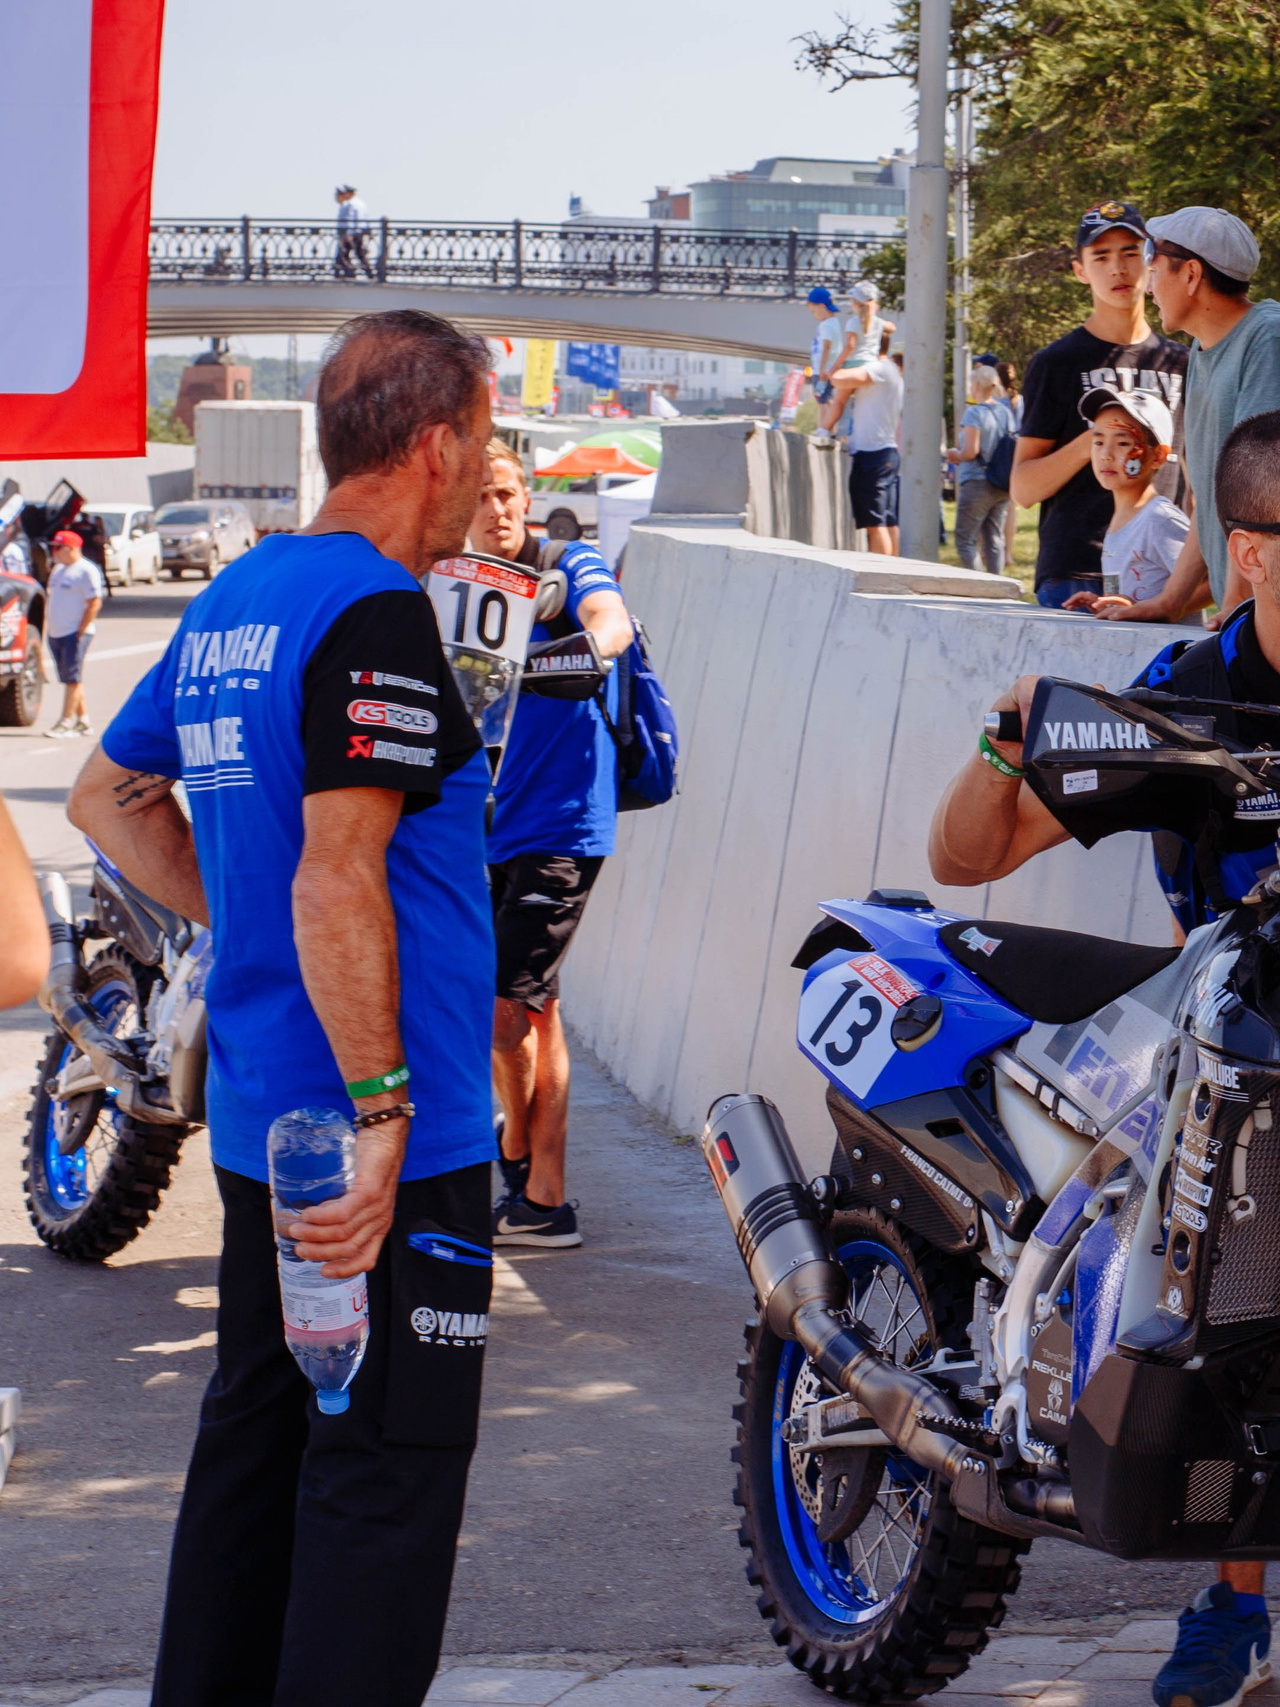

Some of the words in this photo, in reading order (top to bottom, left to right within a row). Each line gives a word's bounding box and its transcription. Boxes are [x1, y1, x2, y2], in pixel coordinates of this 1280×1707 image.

[449, 581, 509, 650] 10
[529, 653, 594, 672] YAMAHA
[354, 704, 386, 721] KS
[386, 708, 431, 728] TOOLS
[1044, 722, 1151, 750] YAMAHA
[809, 979, 882, 1067] 13
[900, 1144, 935, 1179] FRANCO
[1196, 1155, 1218, 1174] Air
[1183, 1204, 1204, 1227] TOOLS
[436, 1310, 489, 1337] YAMA
[418, 1335, 486, 1347] RACIN
[1032, 1359, 1072, 1383] REKLUS
[1039, 1406, 1067, 1426] CAIMI
